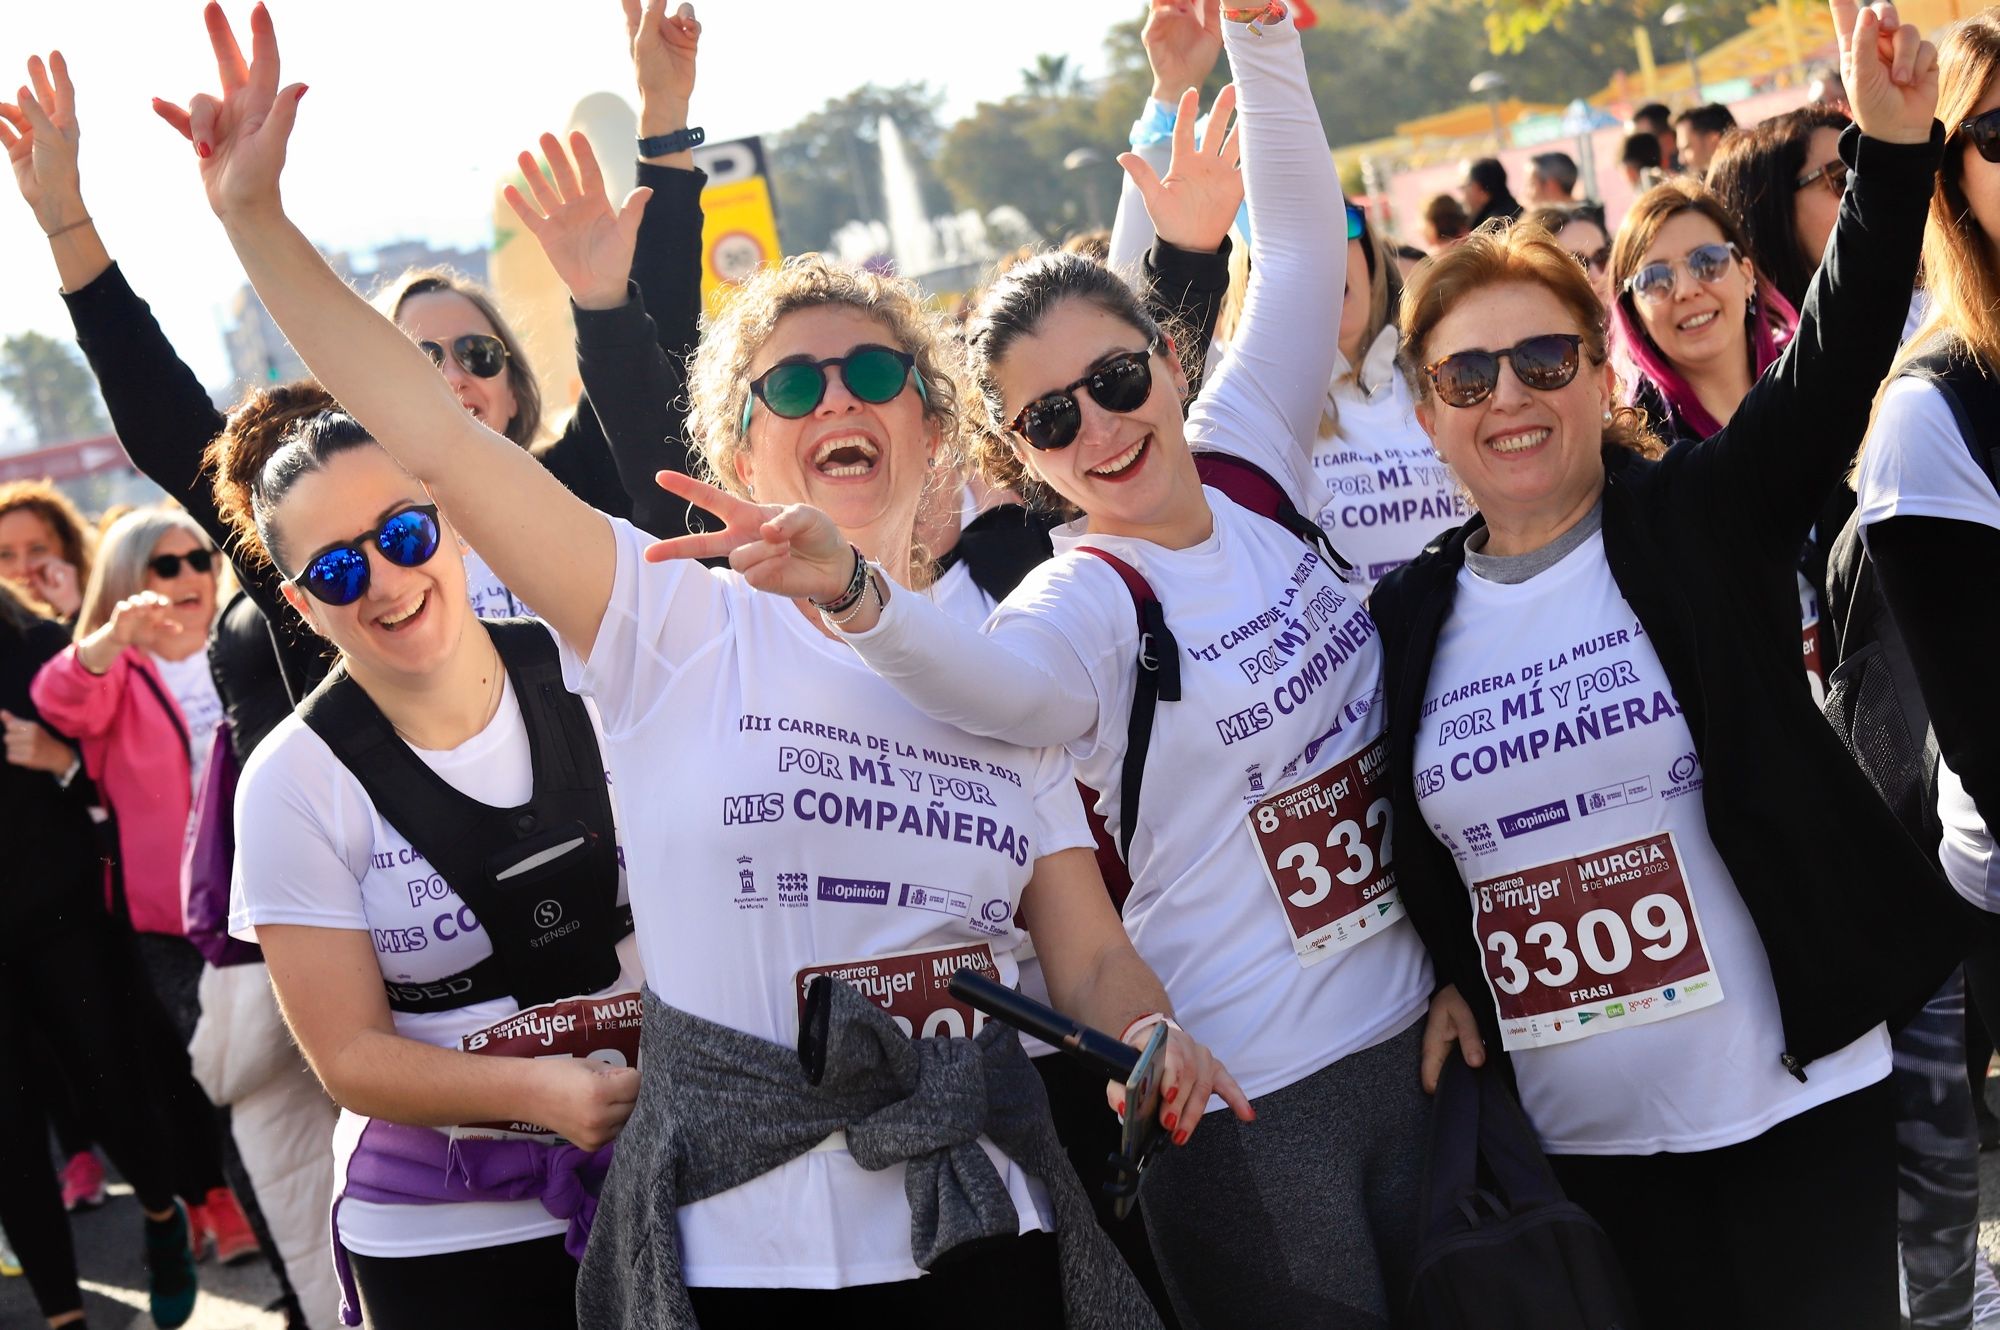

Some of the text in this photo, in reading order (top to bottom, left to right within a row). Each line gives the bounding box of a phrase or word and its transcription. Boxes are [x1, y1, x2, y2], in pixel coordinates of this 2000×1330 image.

[1279, 587, 1299, 607] LA
[1310, 585, 1346, 623] POR
[1441, 672, 1516, 708] CARRERA
[1521, 662, 1543, 682] DE
[1549, 653, 1568, 672] LA
[1571, 629, 1630, 661] MUJER
[1439, 660, 1640, 746] POR MÍ Y POR
[1216, 702, 1274, 746] MIS
[778, 717, 861, 747] CARRERA
[867, 735, 889, 752] DE
[896, 742, 918, 759] LA
[922, 748, 983, 772] MUJER
[986, 763, 1022, 788] 2023
[779, 746, 997, 806] POR MÍ Y POR
[1363, 777, 1369, 786] 5
[1278, 782, 1321, 809] carrera
[1293, 775, 1350, 820] mujer
[723, 788, 1029, 867] MIS COMPAÑERAS
[1276, 797, 1394, 908] 332
[1470, 840, 1497, 853] Murcia
[1578, 843, 1666, 882] MURCIA
[408, 873, 457, 908] PO
[1581, 861, 1670, 892] 5 DE MARZO 2023
[778, 892, 809, 902] Murcia
[1504, 878, 1561, 916] mujer
[374, 927, 428, 953] MIS
[530, 919, 581, 950] STENSED
[1487, 893, 1689, 996] 3309
[829, 965, 879, 981] carrera
[934, 980, 940, 989] 5
[1569, 983, 1614, 1003] FRASI
[492, 1011, 538, 1034] carrera
[507, 1014, 577, 1047] mujer
[596, 1022, 603, 1031] 5
[604, 1021, 617, 1030] DE
